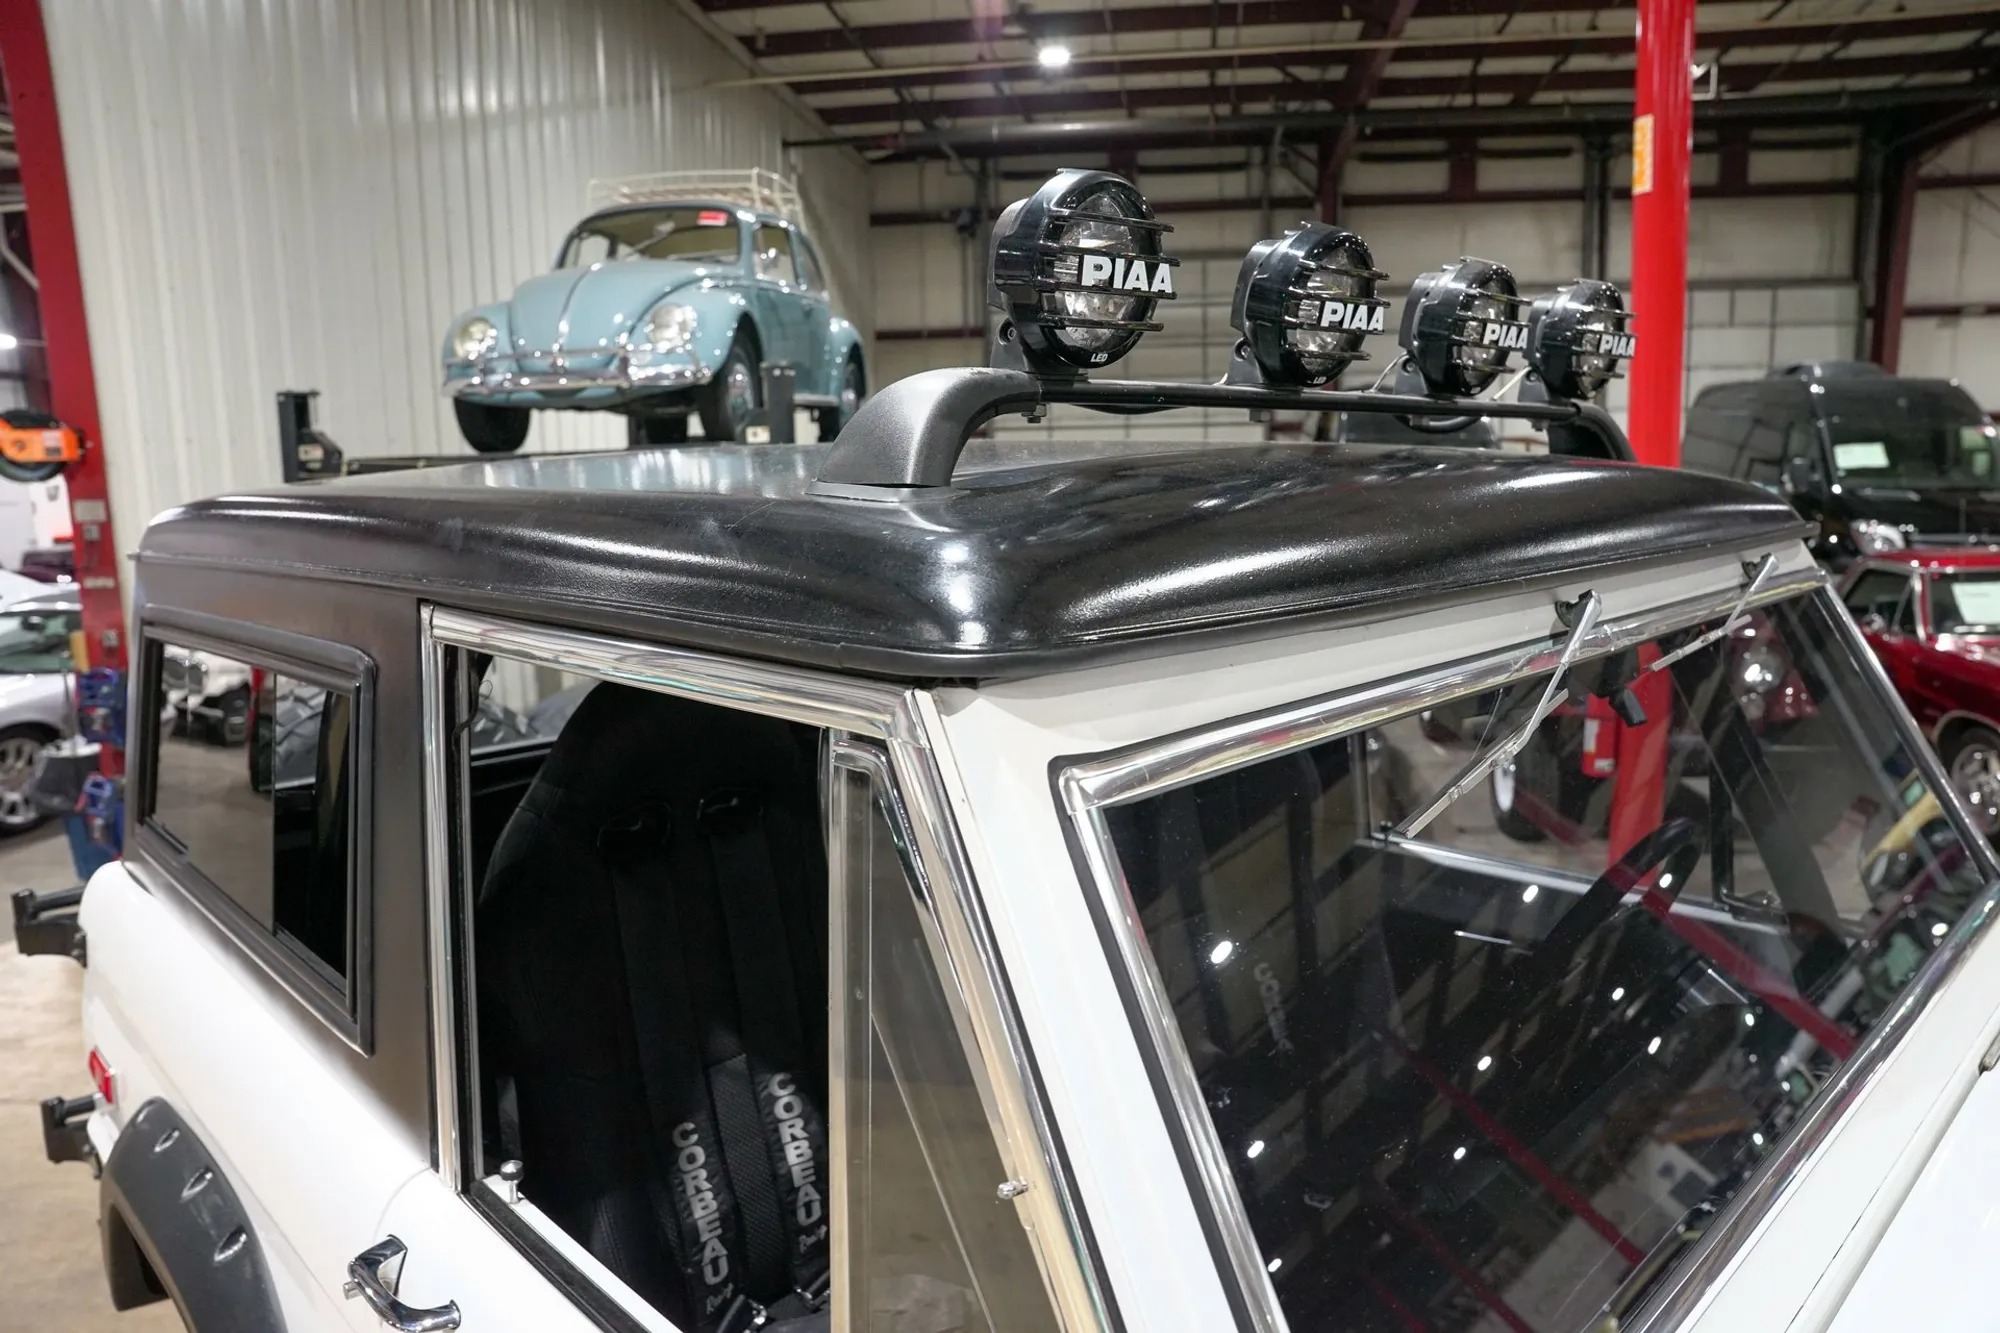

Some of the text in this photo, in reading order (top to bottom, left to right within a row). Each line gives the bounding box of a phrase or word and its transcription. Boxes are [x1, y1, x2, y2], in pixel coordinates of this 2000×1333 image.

[1081, 254, 1174, 294] PIAA
[1320, 300, 1385, 331] PIAA
[1482, 322, 1530, 350] PIAA
[1598, 334, 1637, 357] PIAA
[1090, 353, 1109, 363] LED
[767, 1072, 822, 1227] CORBEAU
[672, 1121, 729, 1286] CORBEAU
